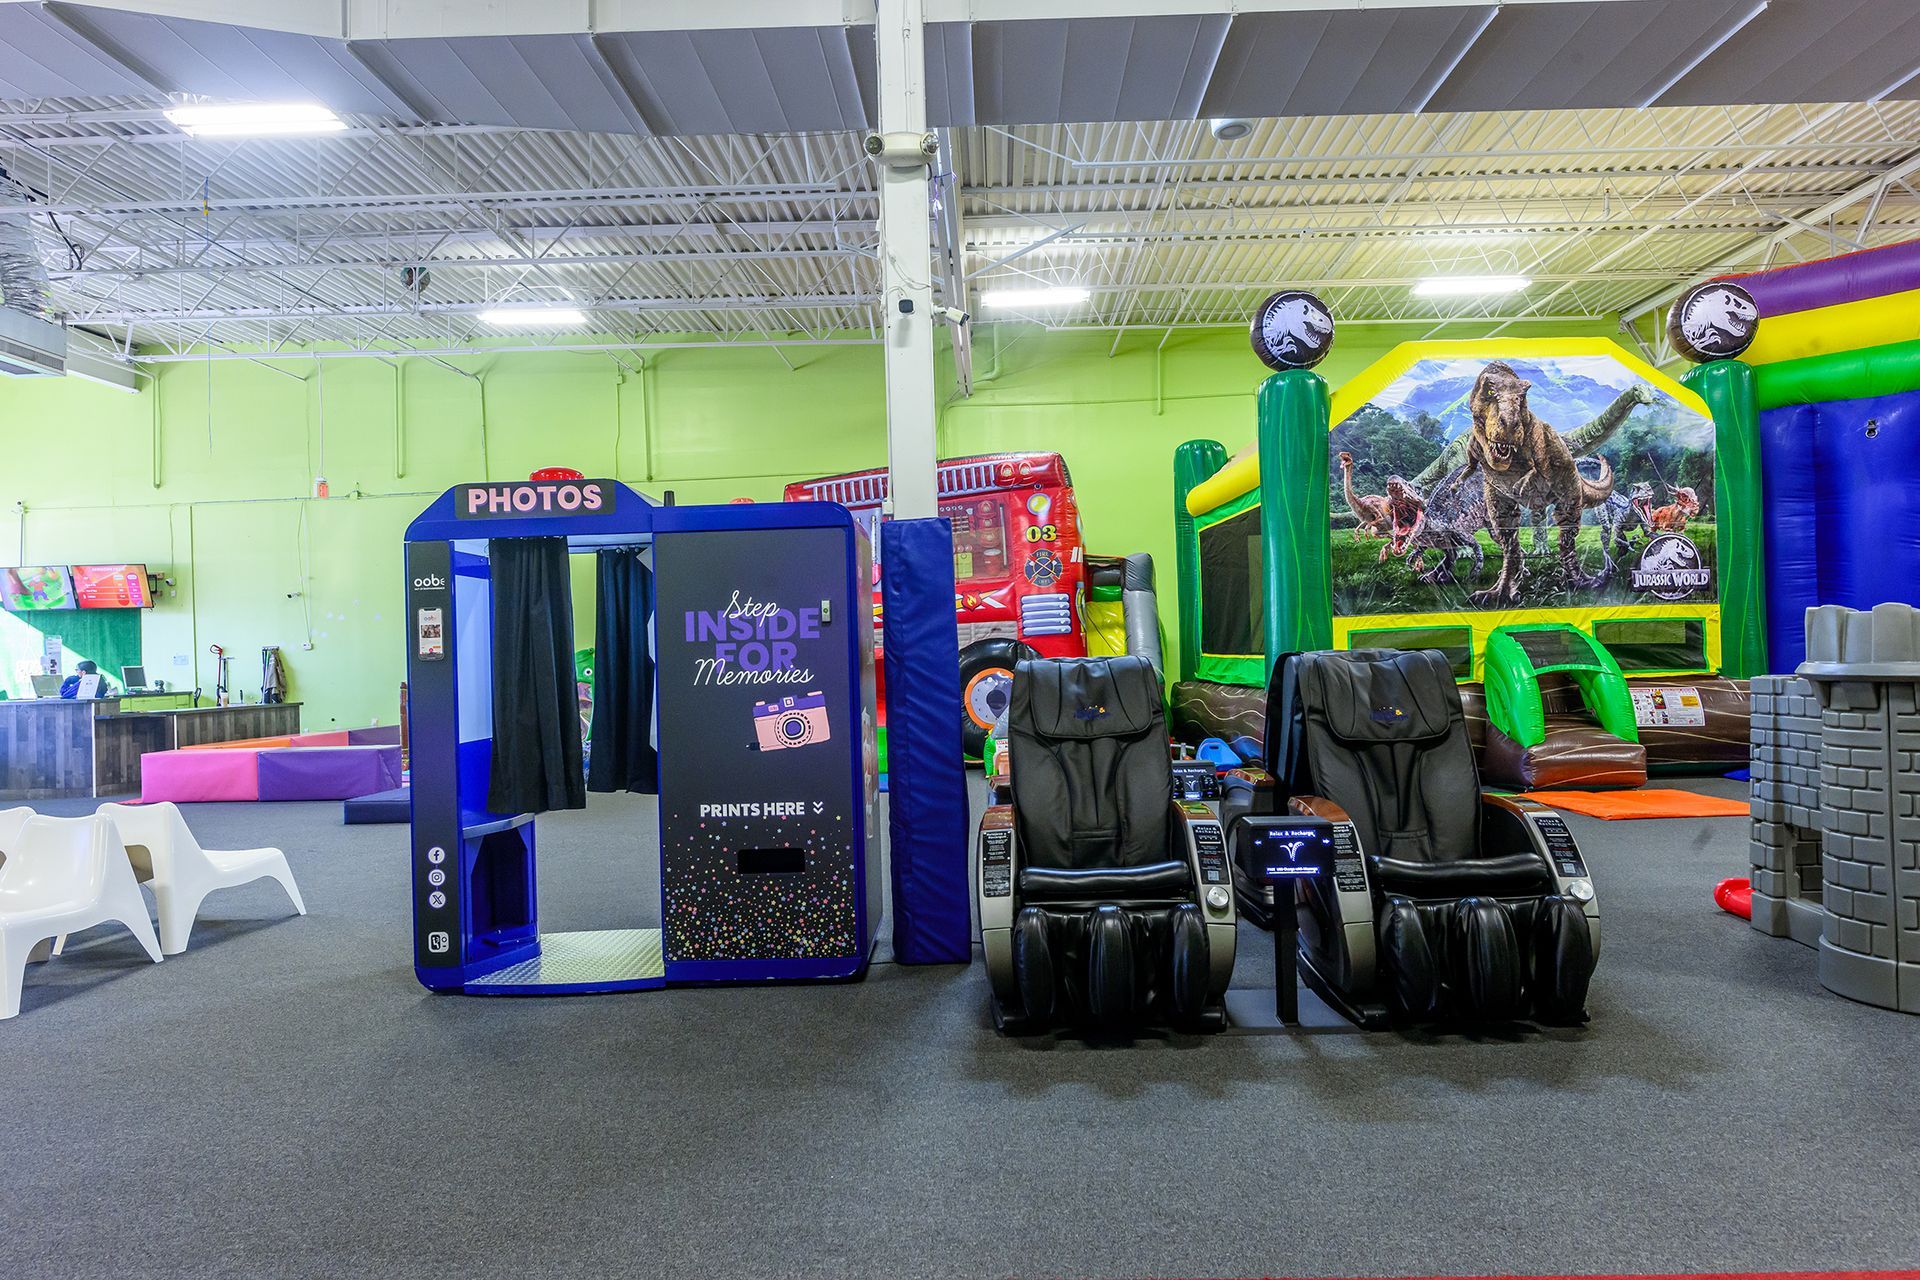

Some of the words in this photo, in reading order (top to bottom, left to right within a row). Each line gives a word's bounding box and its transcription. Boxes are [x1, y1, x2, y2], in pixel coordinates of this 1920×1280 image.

[468, 484, 602, 513] PHOTOS
[1026, 524, 1057, 542] 03
[1633, 572, 1672, 588] JURASSIC
[1672, 572, 1709, 587] WORLD
[723, 589, 780, 627] Step
[685, 607, 821, 642] INSIDE
[715, 641, 798, 674] FOR
[693, 658, 815, 686] Memories
[700, 803, 760, 818] PRINTS
[763, 802, 805, 816] HERE
